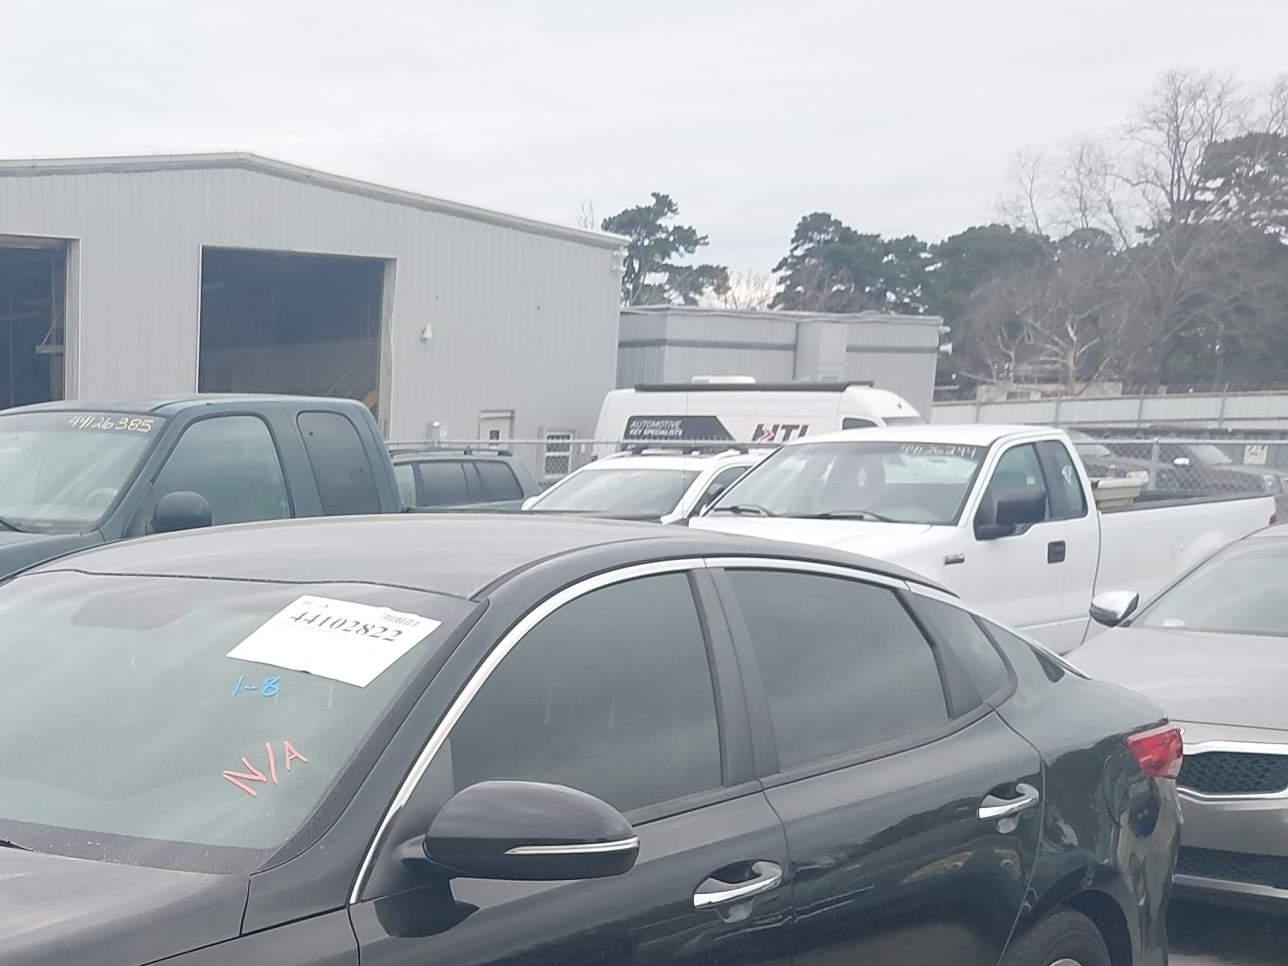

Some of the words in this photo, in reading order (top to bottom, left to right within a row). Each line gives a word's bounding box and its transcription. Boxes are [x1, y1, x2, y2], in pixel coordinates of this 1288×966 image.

[69, 415, 154, 432] 44126385
[630, 420, 682, 429] AUTOMOTIVE
[290, 611, 403, 642] 44102822
[222, 741, 309, 797] N/A
